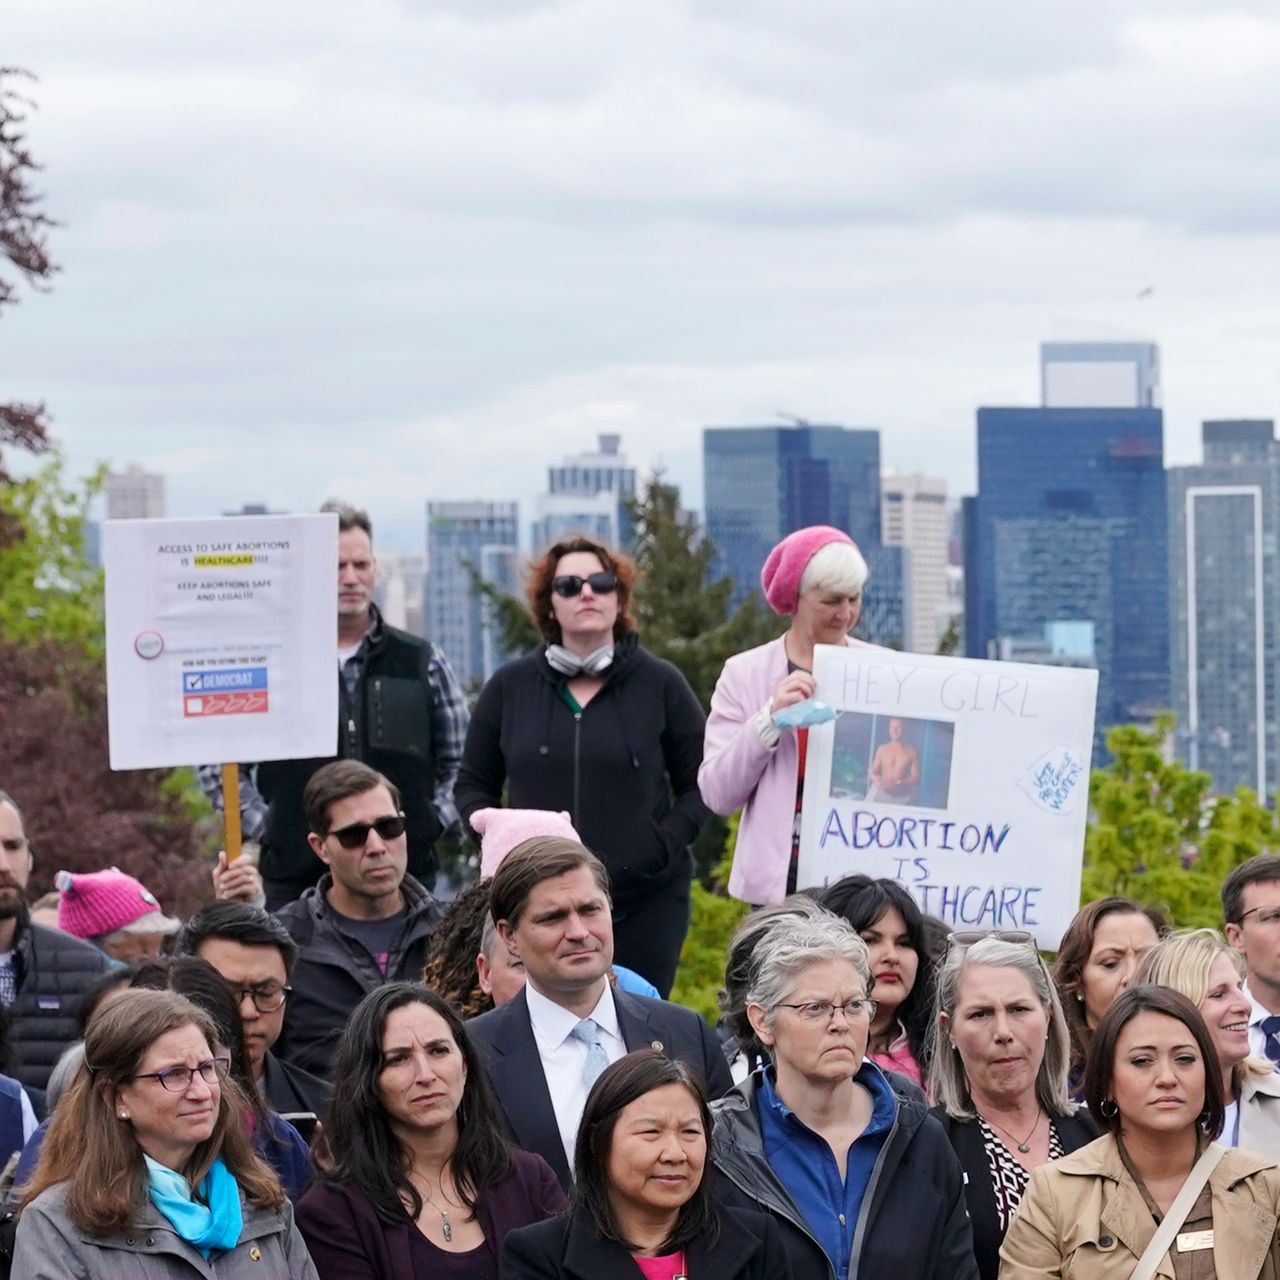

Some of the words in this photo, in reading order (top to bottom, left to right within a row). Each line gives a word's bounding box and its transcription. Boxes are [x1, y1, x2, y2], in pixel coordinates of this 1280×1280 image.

[158, 544, 192, 554] ACCESS
[196, 543, 208, 553] TO
[211, 543, 232, 552] SAFE
[235, 541, 290, 551] ABORTIONS
[180, 558, 189, 567] IS
[177, 582, 198, 590] KEEP
[200, 581, 250, 590] ABORTIONS
[252, 580, 271, 588] SAFE
[196, 593, 215, 601] AND
[203, 672, 253, 688] DEMOCRAT
[843, 662, 918, 706] HEY
[939, 671, 1039, 719] GIRL
[819, 807, 1011, 855] ABORTION
[892, 856, 931, 883] IS
